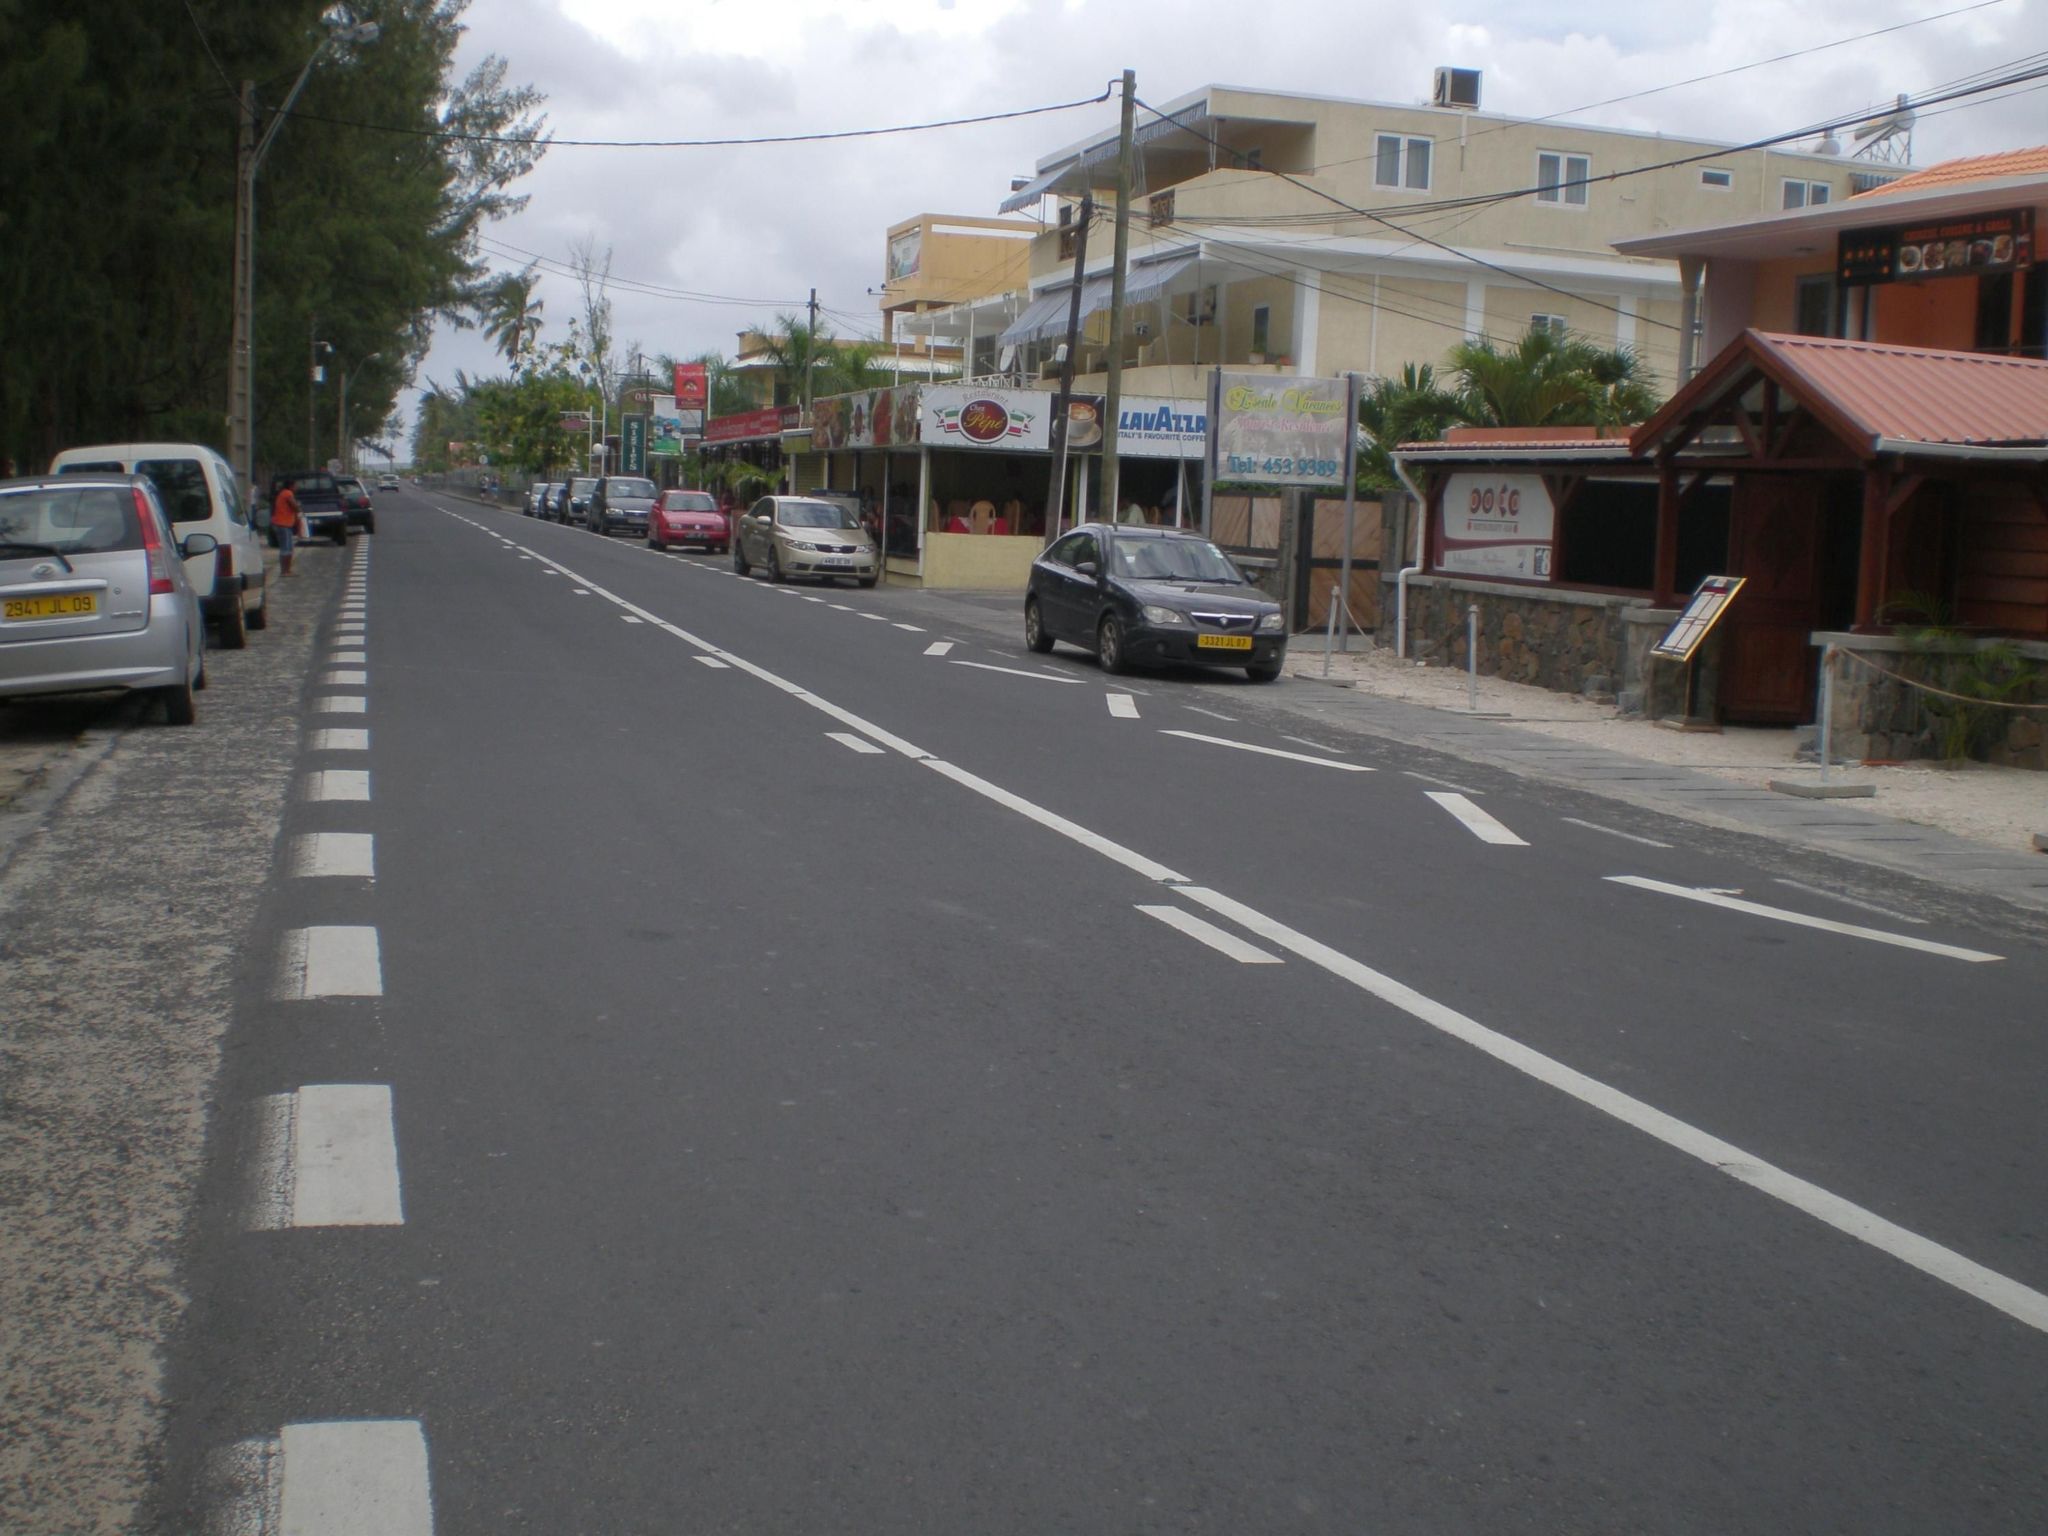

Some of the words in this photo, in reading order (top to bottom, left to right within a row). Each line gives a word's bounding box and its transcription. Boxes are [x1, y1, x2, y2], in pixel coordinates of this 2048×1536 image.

[1119, 406, 1207, 433] LAVAZZA
[1144, 432, 1180, 441] FAVOURITE
[1262, 457, 1293, 475] 453
[1298, 459, 1337, 477] 9389
[5, 601, 41, 617] 2941
[48, 598, 67, 614] JL
[73, 597, 91, 612] 09
